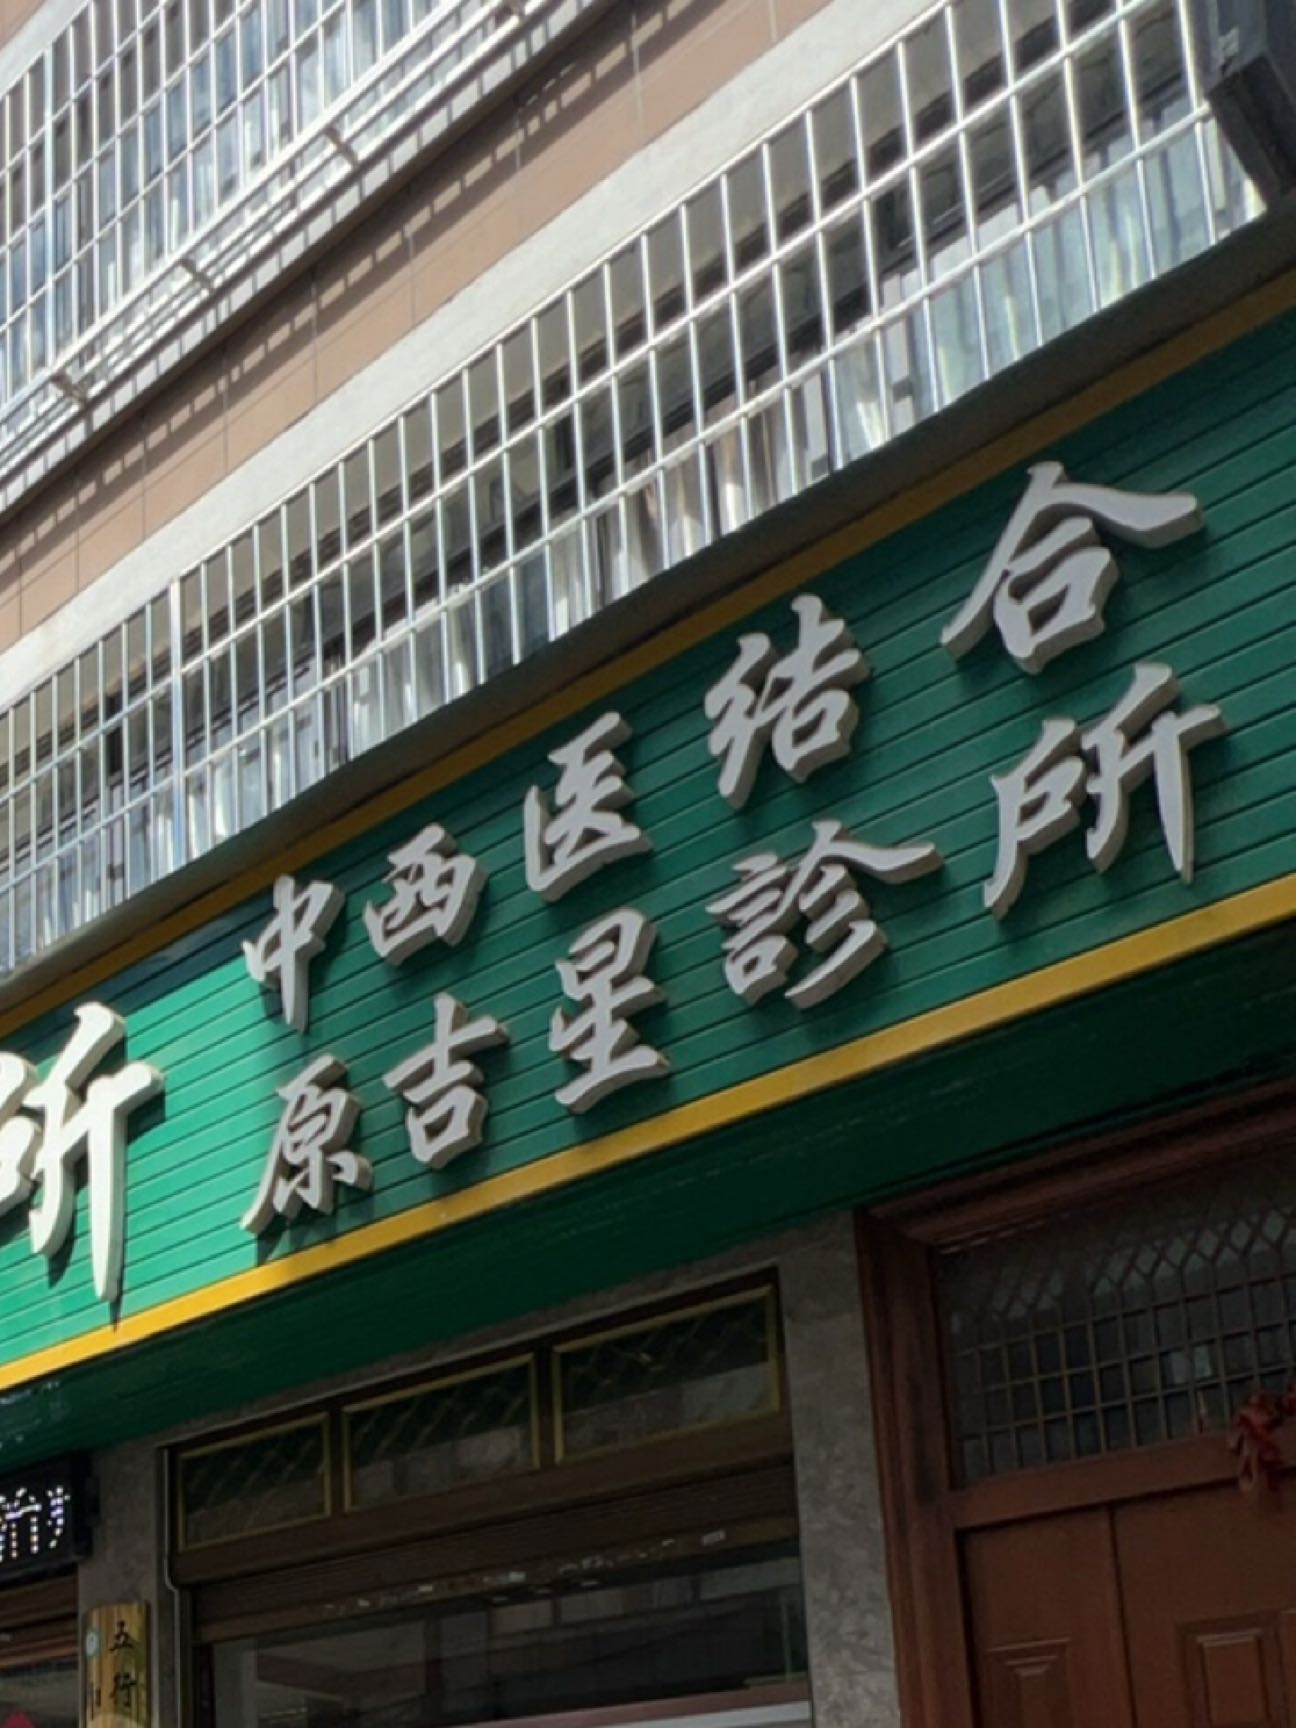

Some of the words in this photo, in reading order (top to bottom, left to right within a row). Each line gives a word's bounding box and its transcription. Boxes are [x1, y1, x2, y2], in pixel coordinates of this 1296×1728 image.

[241, 461, 1209, 1032] 中西医结合
